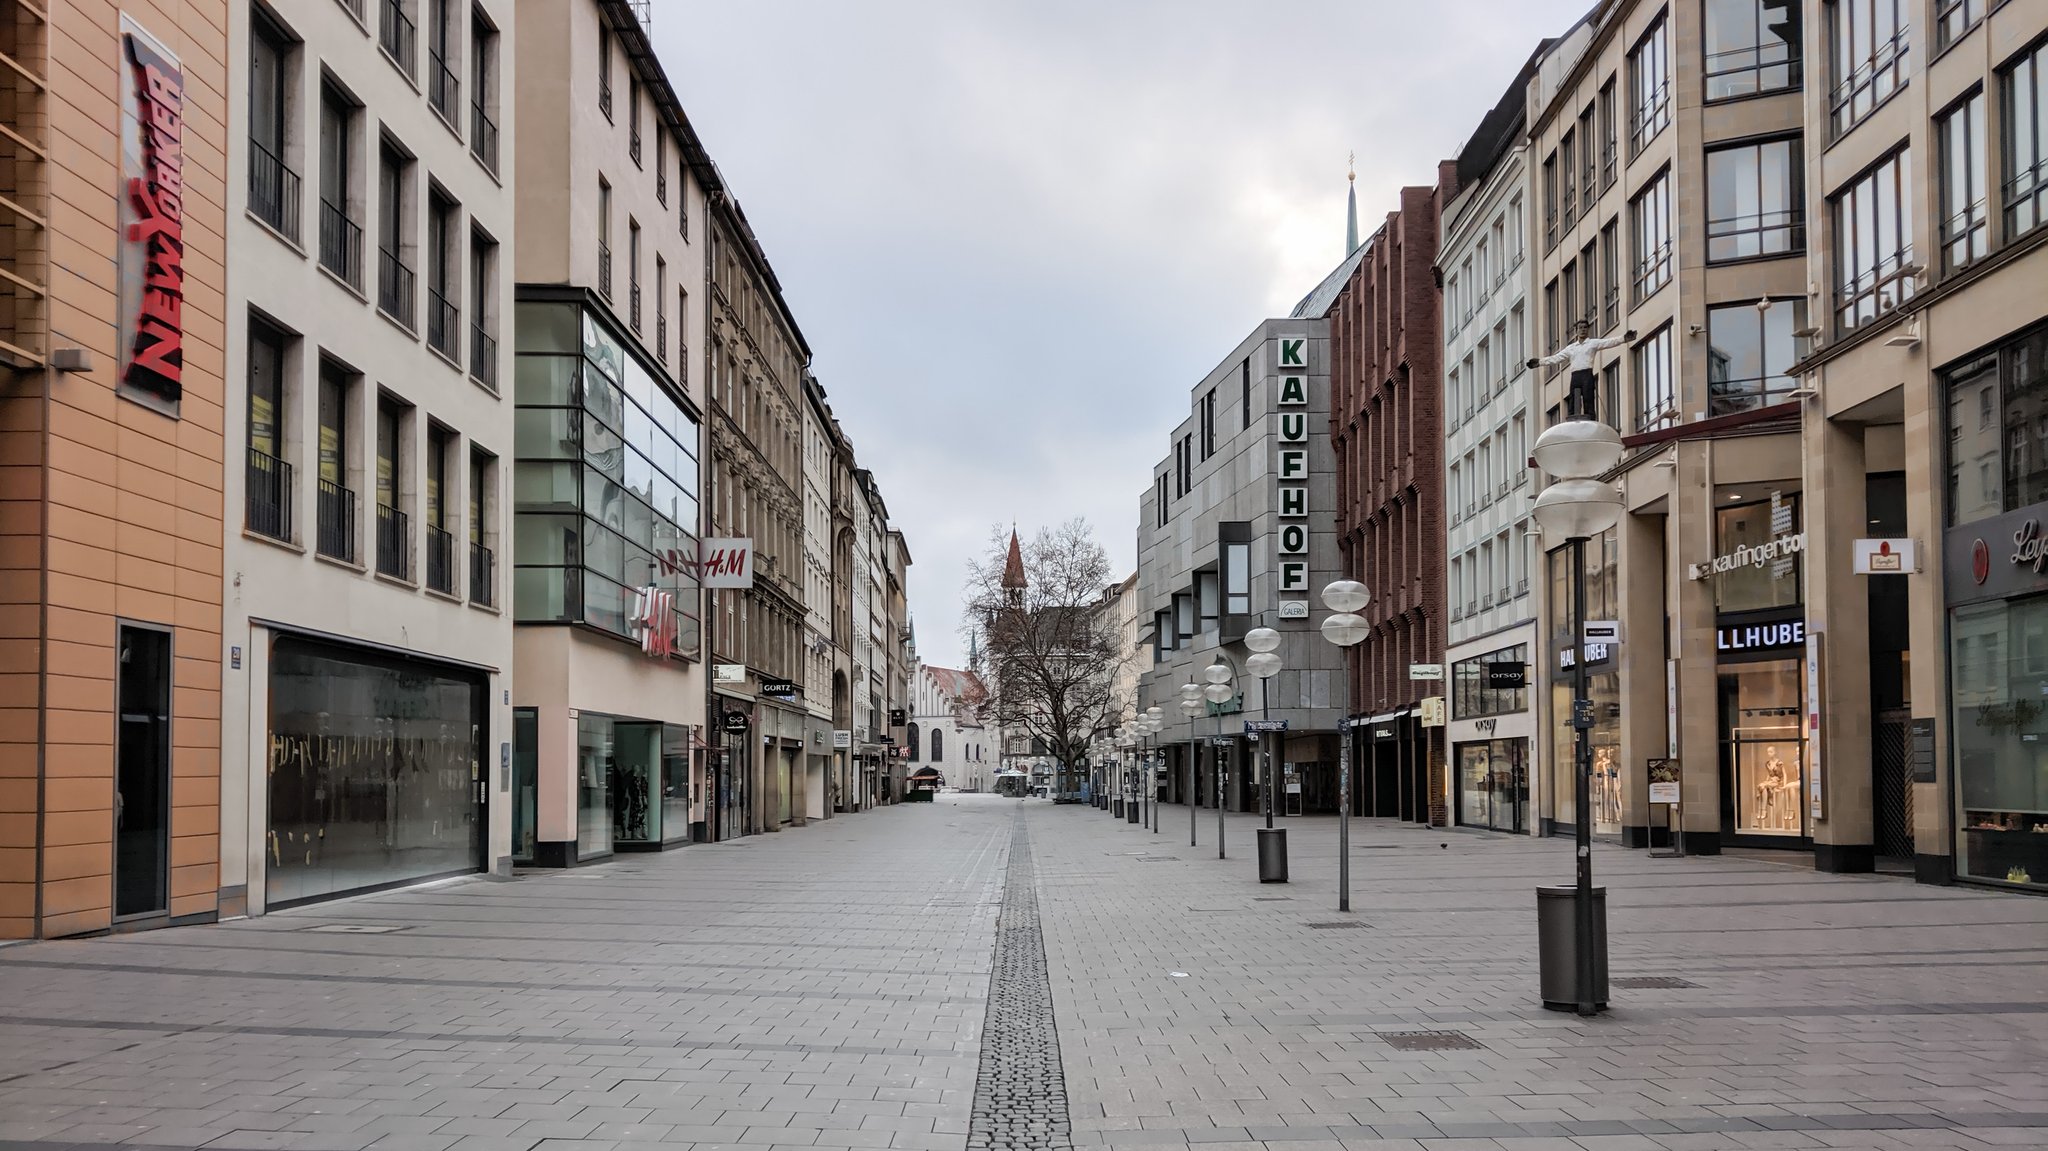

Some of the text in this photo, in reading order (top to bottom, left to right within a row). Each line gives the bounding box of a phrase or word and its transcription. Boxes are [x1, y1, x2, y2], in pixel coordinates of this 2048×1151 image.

[1281, 339, 1305, 589] KAUFHOF
[2010, 519, 2048, 573] Ley
[703, 548, 746, 578] H&M
[1283, 607, 1305, 616] GALERIA
[1717, 622, 1804, 650] LLHUBE
[1560, 643, 1607, 668] HALUBER
[1490, 672, 1524, 681] orsay
[1475, 718, 1497, 737] orsay
